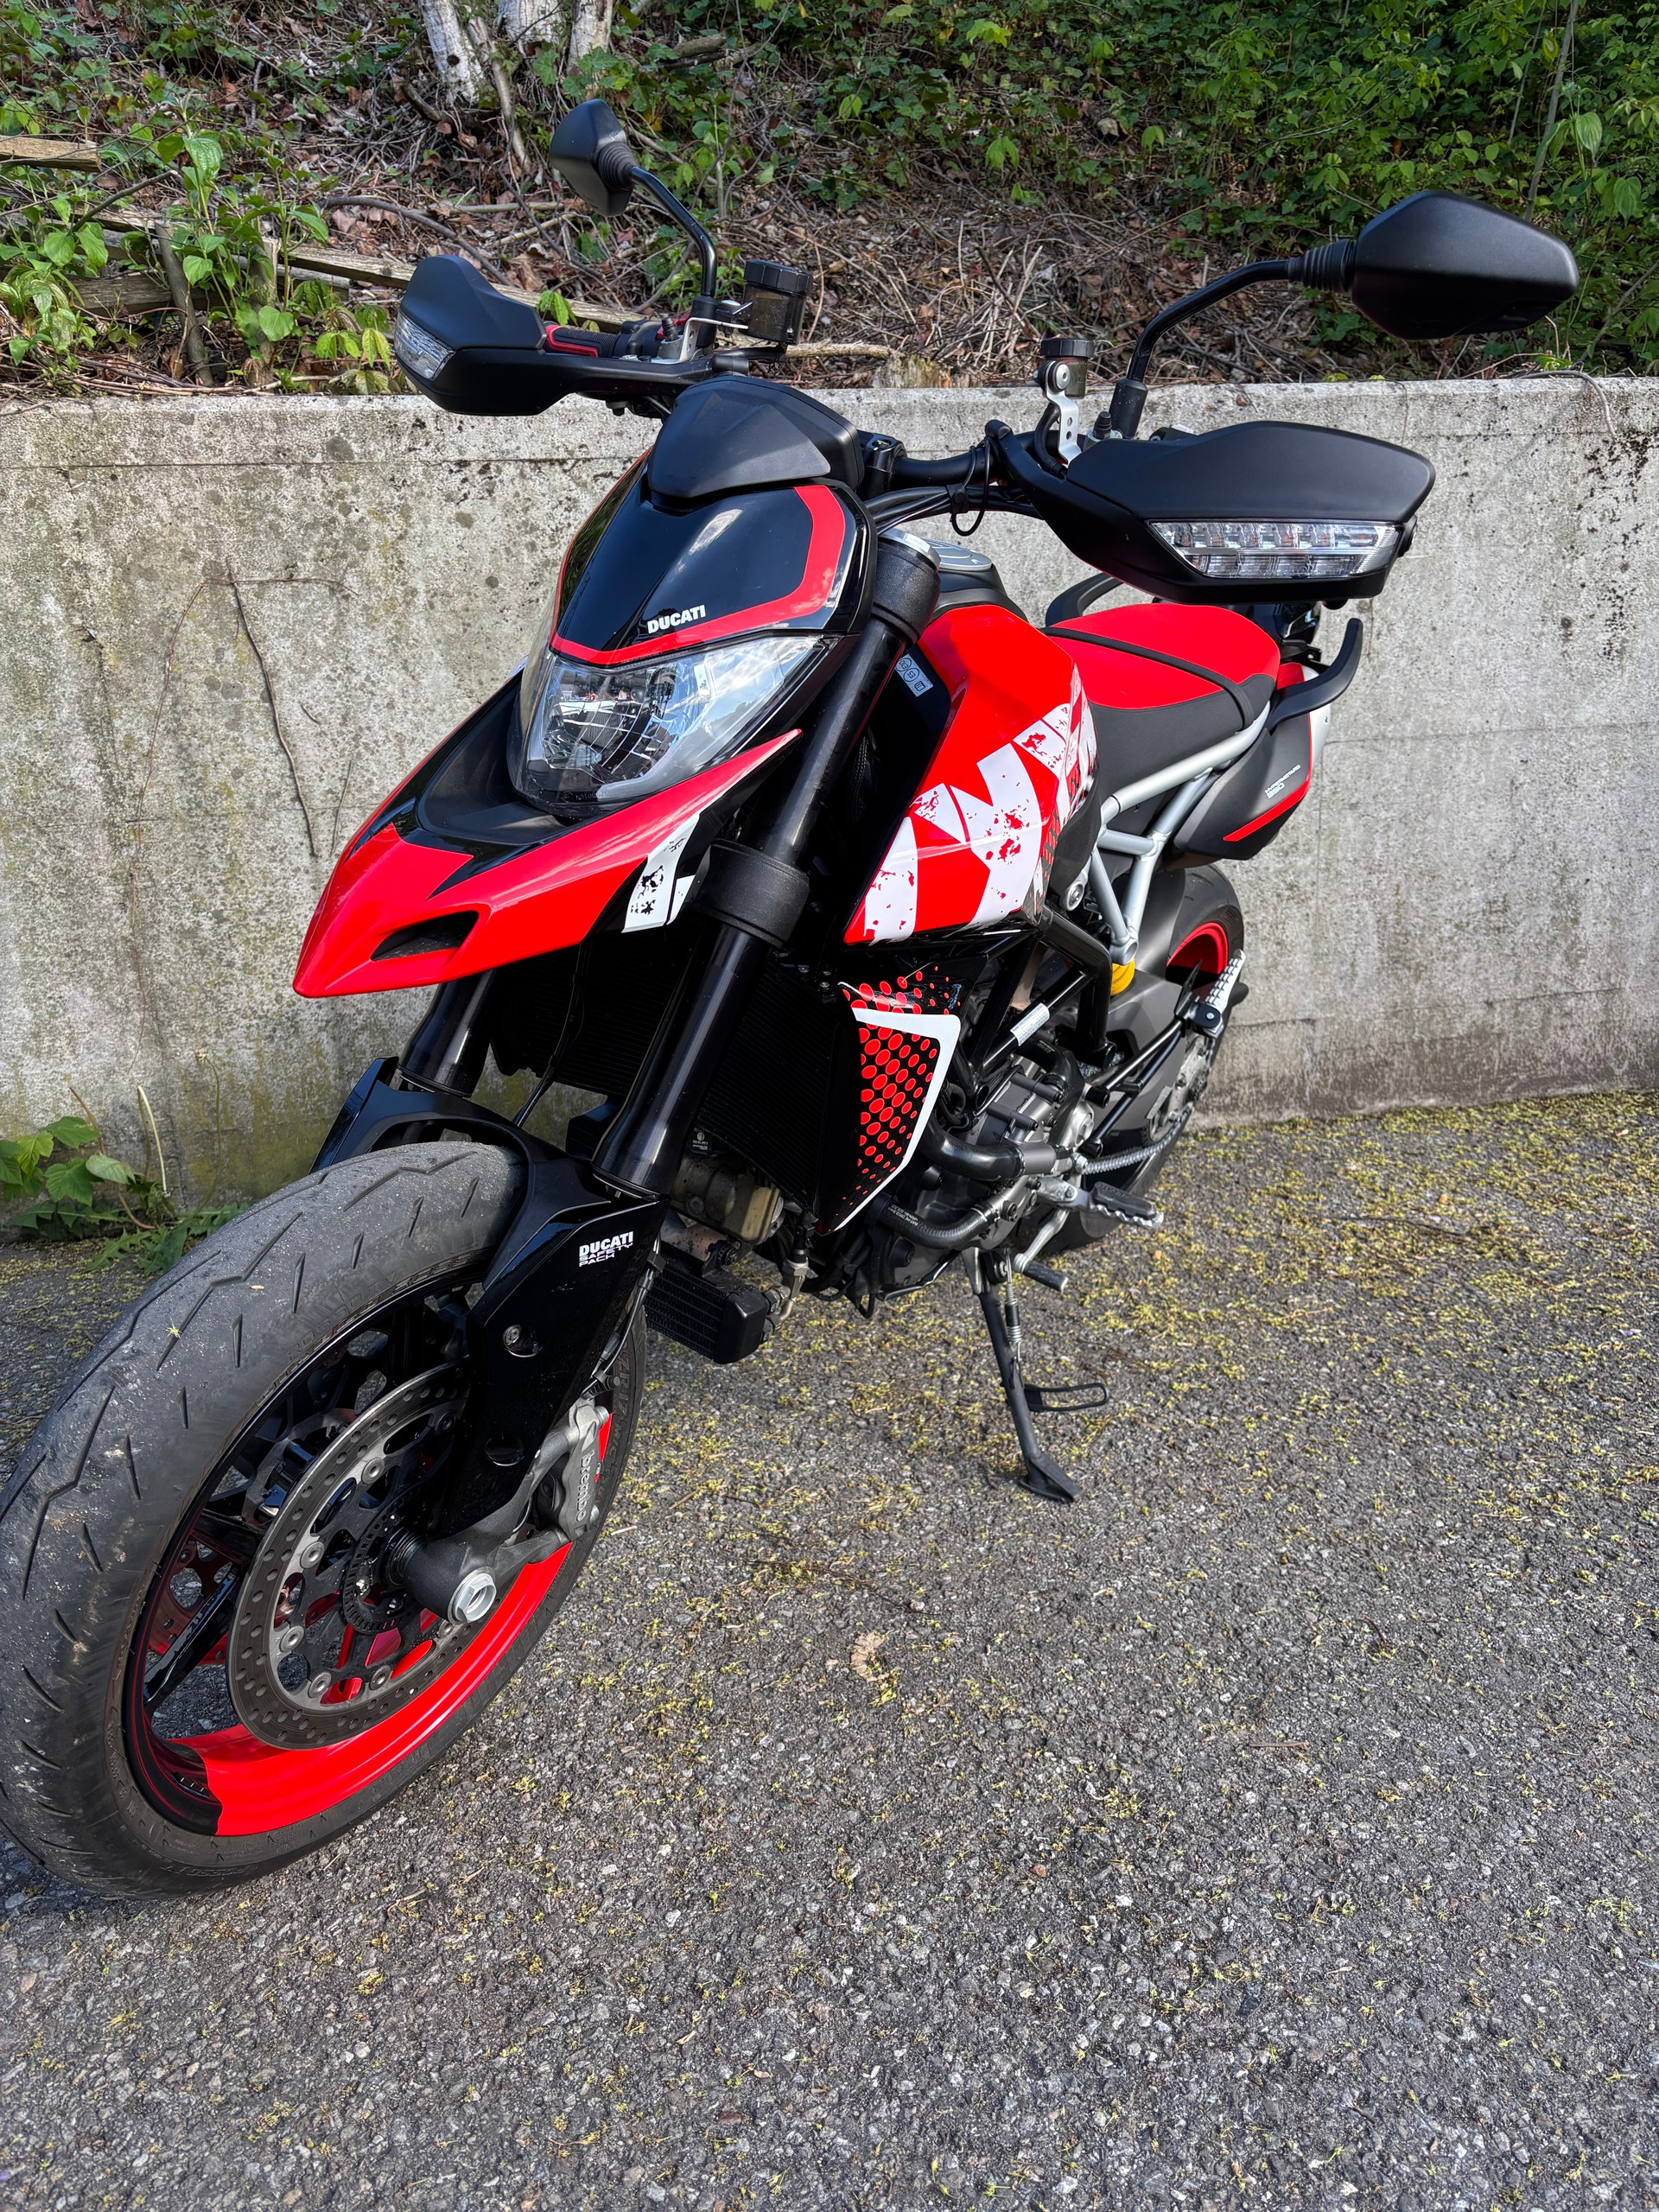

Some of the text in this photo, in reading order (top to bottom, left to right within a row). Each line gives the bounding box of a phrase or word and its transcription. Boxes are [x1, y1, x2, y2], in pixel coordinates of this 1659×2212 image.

[647, 605, 706, 634] DUCATI
[579, 1231, 633, 1256] DUCATI
[579, 1243, 633, 1262] SAFETY
[579, 1253, 615, 1267] PACK
[575, 1450, 594, 1522] brembo
